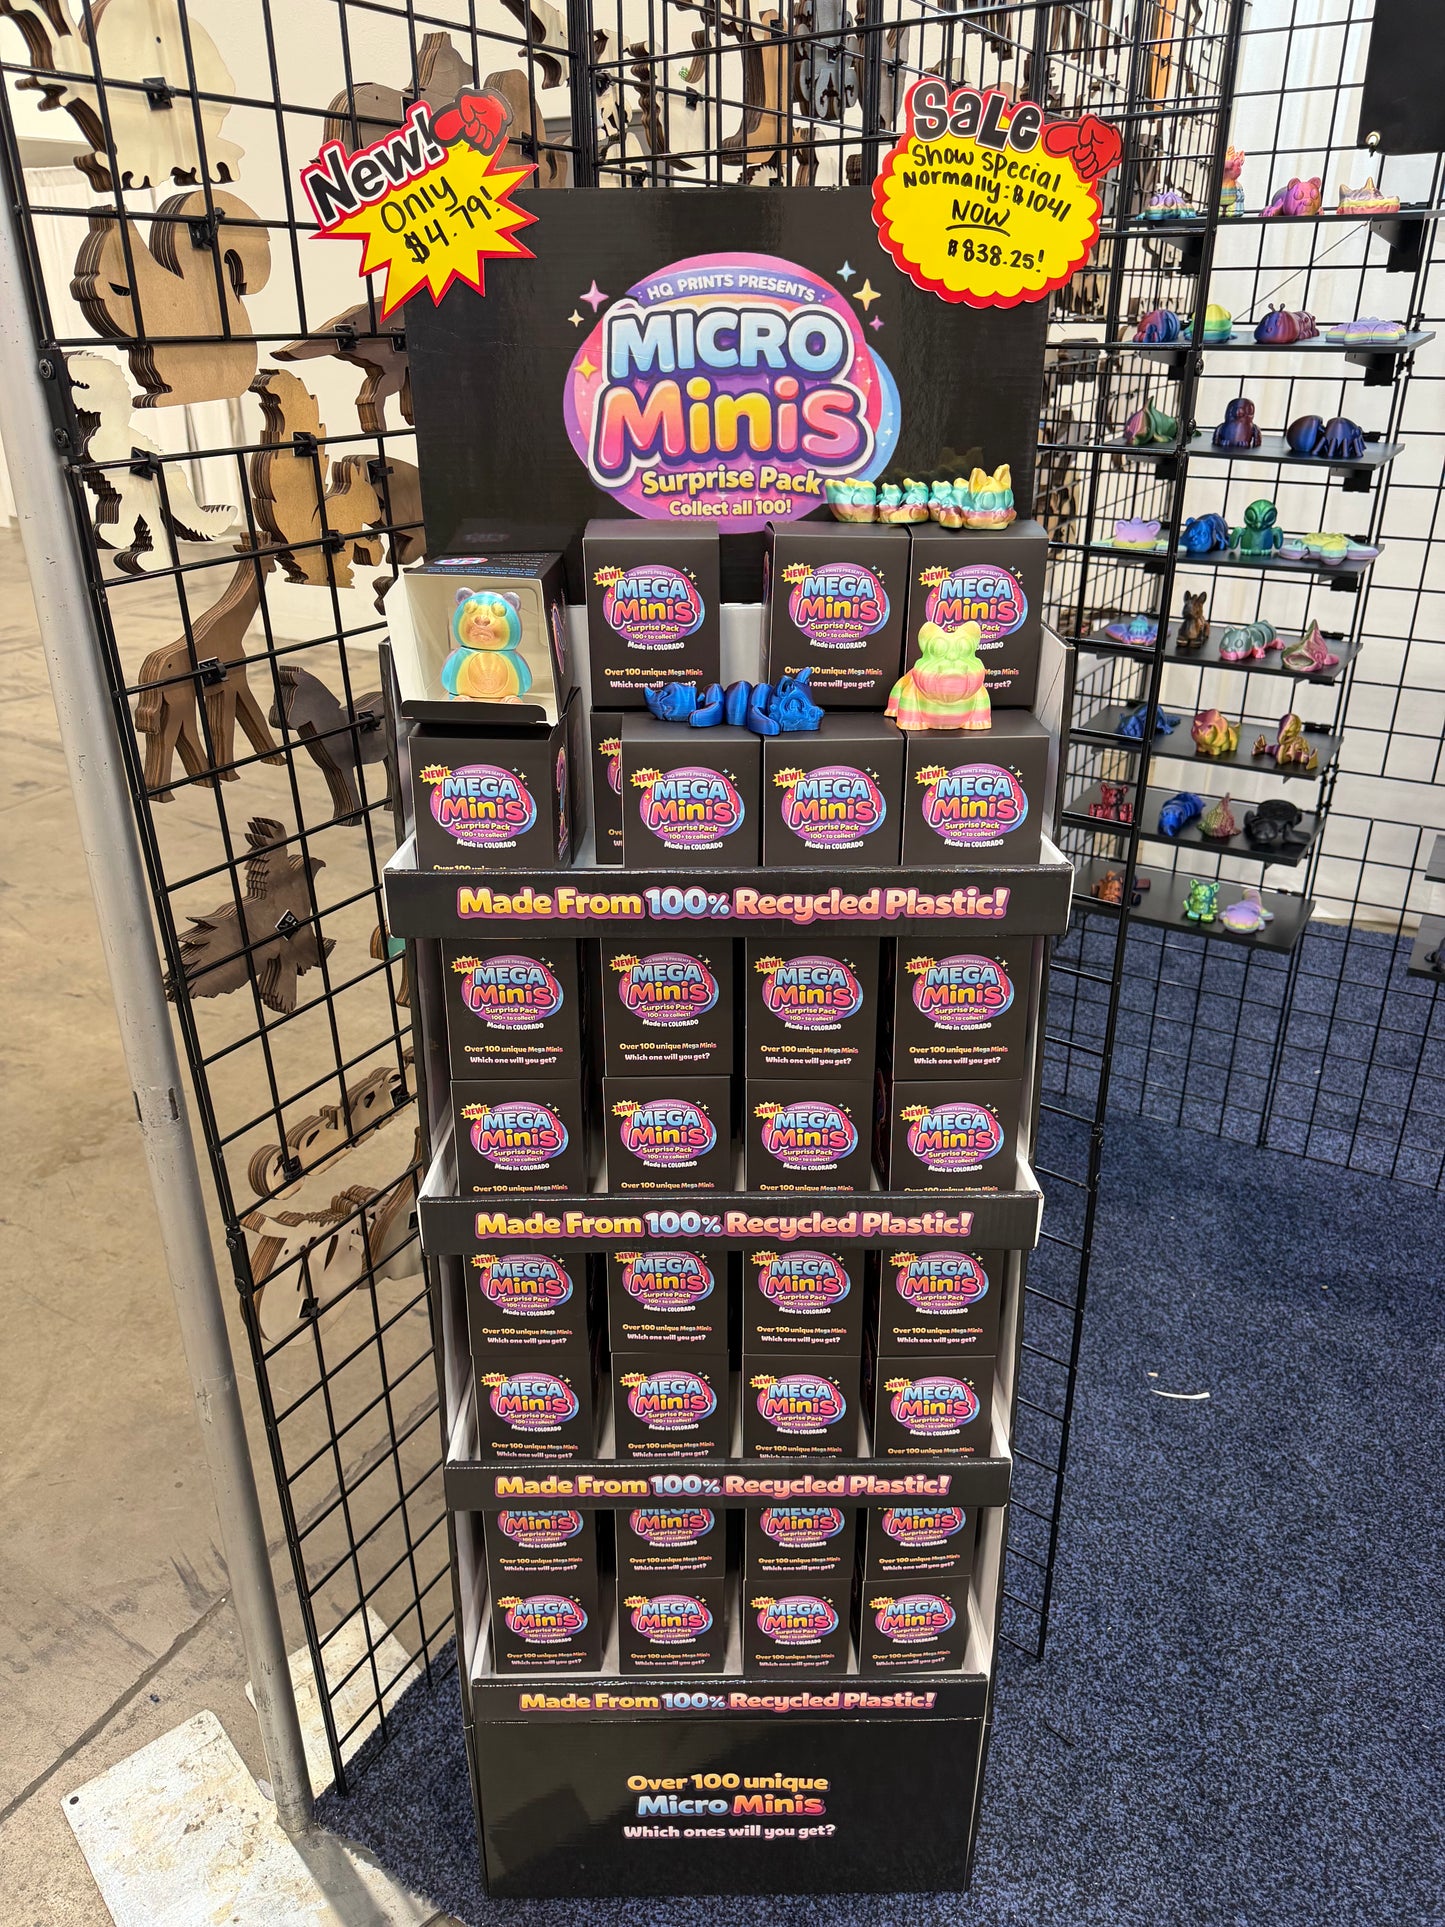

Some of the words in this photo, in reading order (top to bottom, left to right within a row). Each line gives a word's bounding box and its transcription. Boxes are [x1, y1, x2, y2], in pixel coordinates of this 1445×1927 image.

[912, 144, 974, 166] Show
[307, 109, 442, 223] New!
[380, 175, 458, 234] Only
[951, 199, 1010, 227] NOW
[403, 187, 501, 264] $4.79!
[947, 238, 1045, 272] $838.25!
[647, 283, 674, 301] HQ
[678, 274, 734, 293] PRINTS
[738, 274, 816, 303] PRESENTS
[611, 310, 844, 379] MICRO
[598, 375, 860, 470] Minis
[642, 464, 756, 496] Surprise
[760, 466, 823, 496] Pack
[669, 499, 728, 516] Collect
[732, 499, 753, 516] all
[755, 499, 792, 515] 100!
[596, 569, 622, 582] NEW!
[786, 566, 811, 578] NEW!
[922, 569, 948, 582] NEW!
[617, 579, 688, 600] MEGA
[804, 576, 875, 598] MEGA
[940, 578, 1012, 599] MEGA
[612, 598, 697, 626] Minis
[799, 596, 881, 623] Minis
[937, 597, 1018, 624] Minis
[626, 624, 660, 633] Surprise
[661, 624, 680, 632] Pack
[627, 641, 646, 650] Made
[653, 642, 685, 651] COLORADO
[604, 668, 625, 676] Over
[625, 668, 640, 676] 100
[641, 668, 667, 677] unique
[667, 669, 685, 677] Mega
[423, 767, 448, 779] NEW!
[634, 771, 659, 783] NEW!
[776, 771, 802, 782] NEW!
[919, 769, 945, 781] NEW!
[444, 777, 518, 799] MEGA
[654, 780, 728, 801] MEGA
[797, 778, 869, 799] MEGA
[938, 777, 1013, 798] MEGA
[440, 796, 527, 824] Minis
[650, 799, 736, 826] Minis
[793, 797, 877, 825] Minis
[934, 796, 1019, 824] Minis
[459, 887, 552, 914] Made
[556, 888, 642, 914] From
[645, 888, 730, 915] 100%
[735, 888, 880, 920] Recycled
[885, 888, 1009, 916] Plastic!
[475, 966, 546, 986] MEGA
[632, 964, 703, 983] MEGA
[776, 967, 847, 986] MEGA
[927, 966, 998, 986] MEGA
[471, 983, 555, 1009] Minis
[629, 981, 710, 1006] Minis
[772, 984, 854, 1009] Minis
[923, 983, 1007, 1009] Minis
[485, 1007, 518, 1016] Surprise
[519, 1007, 538, 1015] Pack
[501, 1046, 526, 1054] unique
[527, 1046, 545, 1054] Mega
[470, 1056, 493, 1064] Which
[524, 1058, 538, 1066] you
[540, 1056, 557, 1065] get?
[483, 1112, 551, 1131] MEGA
[634, 1109, 701, 1128] MEGA
[775, 1112, 842, 1130] MEGA
[921, 1113, 989, 1131] MEGA
[480, 1128, 560, 1152] Minis
[630, 1126, 709, 1150] Minis
[772, 1128, 850, 1151] Minis
[916, 1129, 996, 1153] Minis
[477, 1213, 561, 1235] Made
[565, 1213, 642, 1234] From
[645, 1211, 721, 1235] 100%
[727, 1212, 857, 1238] Recycled
[861, 1212, 972, 1235] Plastic!
[492, 1262, 557, 1279] MEGA
[634, 1258, 699, 1275] MEGA
[771, 1260, 835, 1277] MEGA
[910, 1260, 974, 1277] MEGA
[489, 1277, 564, 1299] Minis
[631, 1273, 706, 1295] Minis
[767, 1275, 841, 1297] Minis
[905, 1275, 980, 1297] Minis
[790, 1326, 814, 1334] unique
[825, 1335, 841, 1344] get?
[500, 1383, 563, 1399] MEGA
[639, 1381, 701, 1396] MEGA
[768, 1384, 831, 1399] MEGA
[903, 1386, 966, 1401] MEGA
[497, 1397, 571, 1418] Minis
[636, 1395, 709, 1415] Minis
[764, 1398, 838, 1419] Minis
[899, 1400, 972, 1421] Minis
[497, 1476, 573, 1494] Made
[577, 1476, 648, 1494] From
[650, 1475, 721, 1494] 100%
[725, 1475, 845, 1497] Recycled
[850, 1475, 950, 1495] Plastic!
[506, 1515, 576, 1535] Minis
[638, 1514, 707, 1534] Minis
[515, 1602, 574, 1615] MEGA
[641, 1601, 699, 1615] MEGA
[768, 1602, 826, 1616] MEGA
[887, 1600, 943, 1614] MEGA
[513, 1613, 581, 1631] Minis
[638, 1613, 706, 1631] Minis
[764, 1613, 831, 1632] Minis
[883, 1612, 950, 1631] Minis
[520, 1693, 592, 1708] Made
[595, 1693, 659, 1708] From
[661, 1692, 726, 1708] 100%
[729, 1692, 840, 1712] Recycled
[844, 1691, 936, 1709] Plastic!
[627, 1775, 689, 1790] Over
[691, 1773, 740, 1790] 100
[743, 1773, 828, 1793] unique
[637, 1795, 728, 1815] Micro
[732, 1793, 824, 1814] Minis
[624, 1825, 680, 1838] Which
[683, 1826, 726, 1838] ones
[728, 1825, 761, 1838] will
[764, 1827, 795, 1839] you
[798, 1824, 836, 1839] get?
